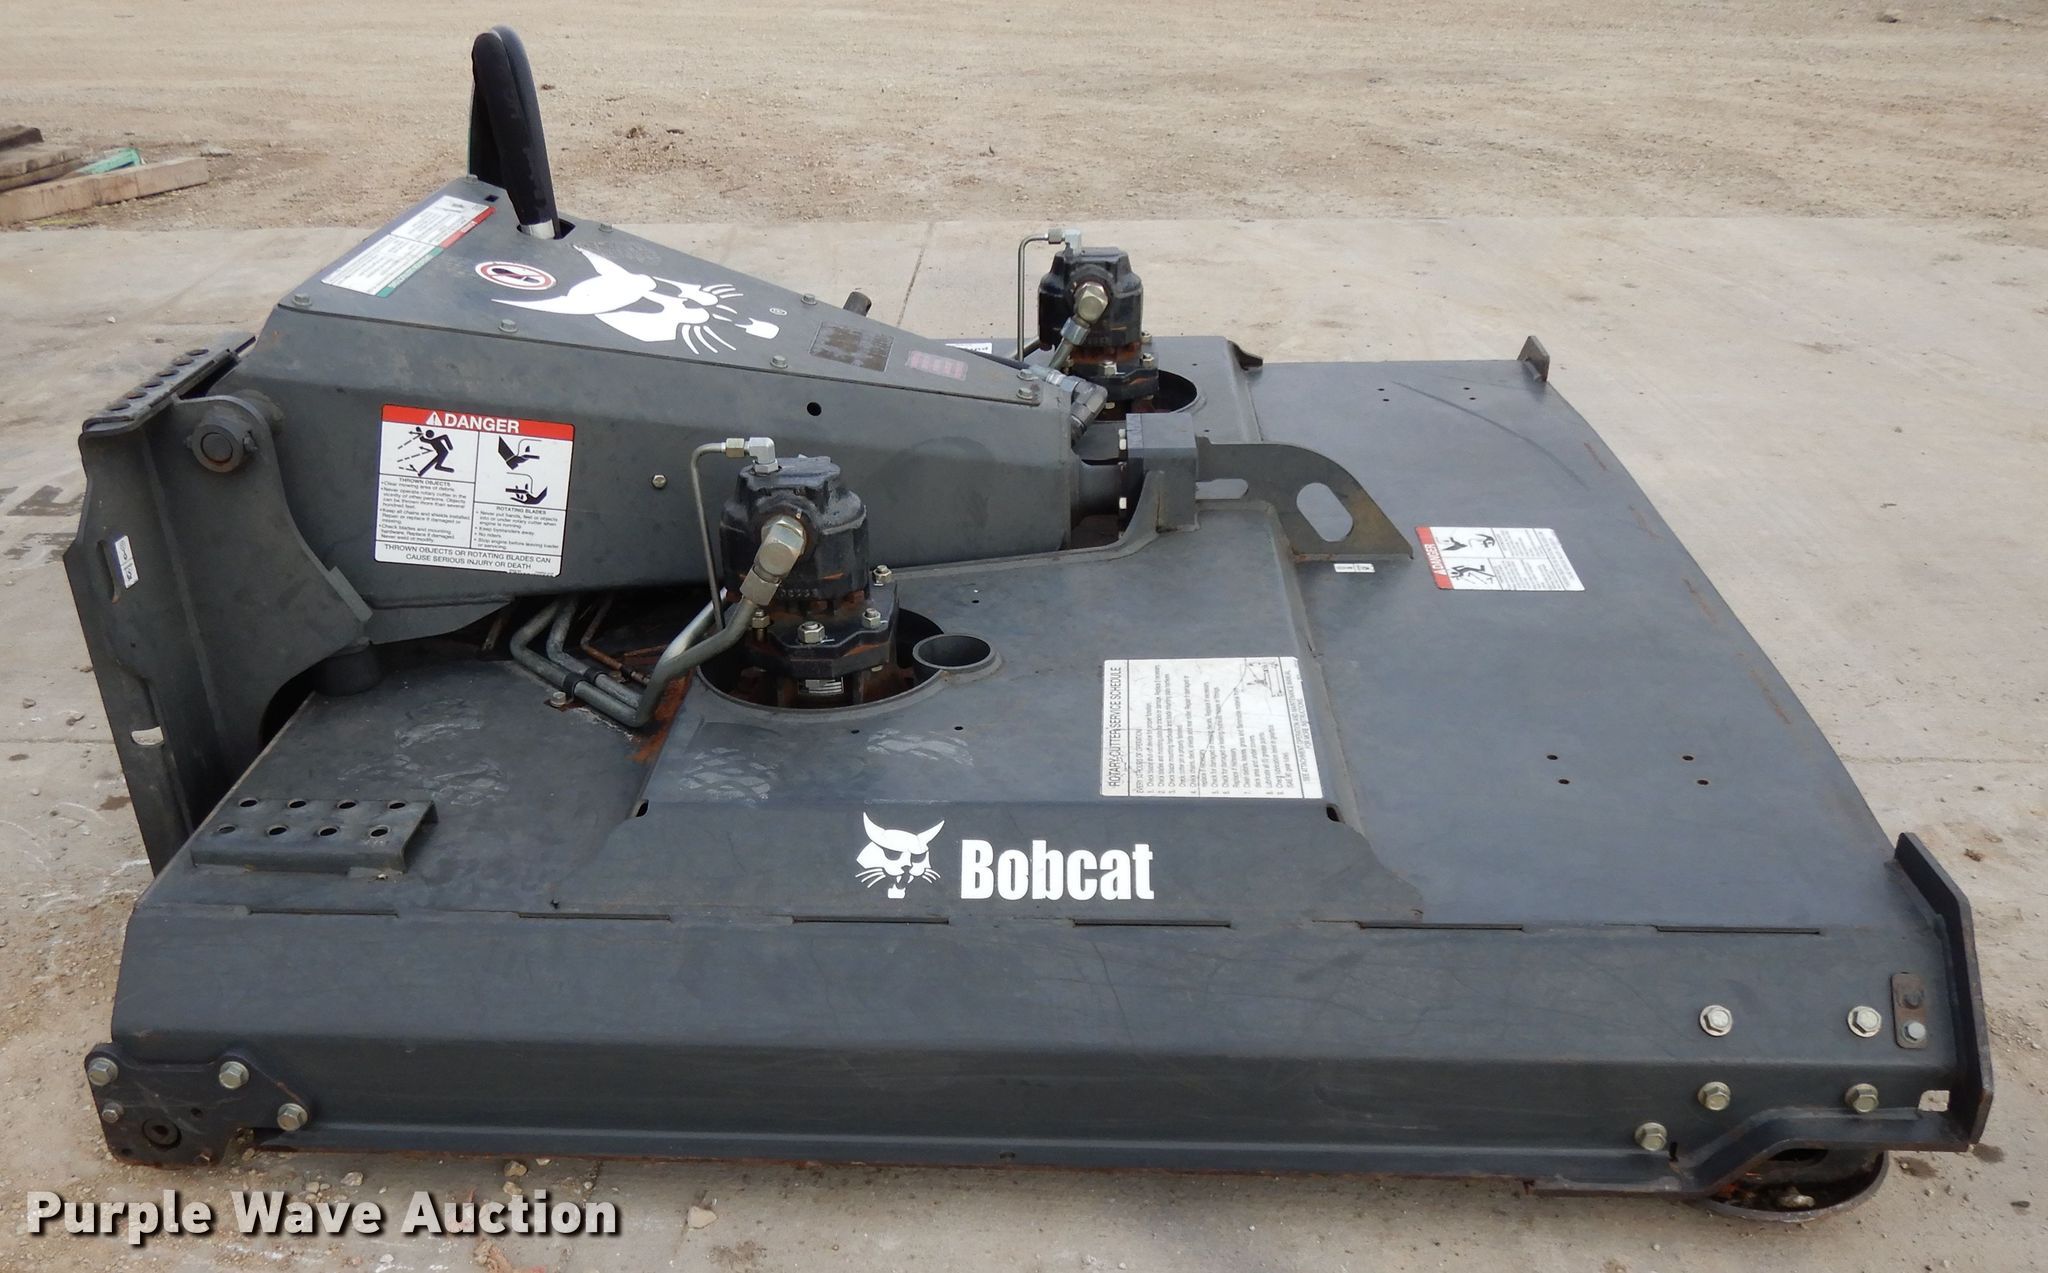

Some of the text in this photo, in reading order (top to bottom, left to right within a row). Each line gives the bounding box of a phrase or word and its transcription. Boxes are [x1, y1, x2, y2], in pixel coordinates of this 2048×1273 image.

[444, 413, 519, 433] DANGER
[384, 544, 417, 552] THROWN
[419, 546, 453, 555] OBJECTS
[468, 550, 504, 559] ROTATING
[506, 554, 534, 562] BLADES
[406, 554, 432, 562] CAUSE
[433, 555, 465, 564] SERIOUS
[467, 559, 493, 567] INJURY
[1424, 544, 1443, 571] DANGER
[1109, 667, 1121, 786] ROTARY CUTTER SERVICE SCHEDULE
[961, 839, 1154, 900] Bobcat
